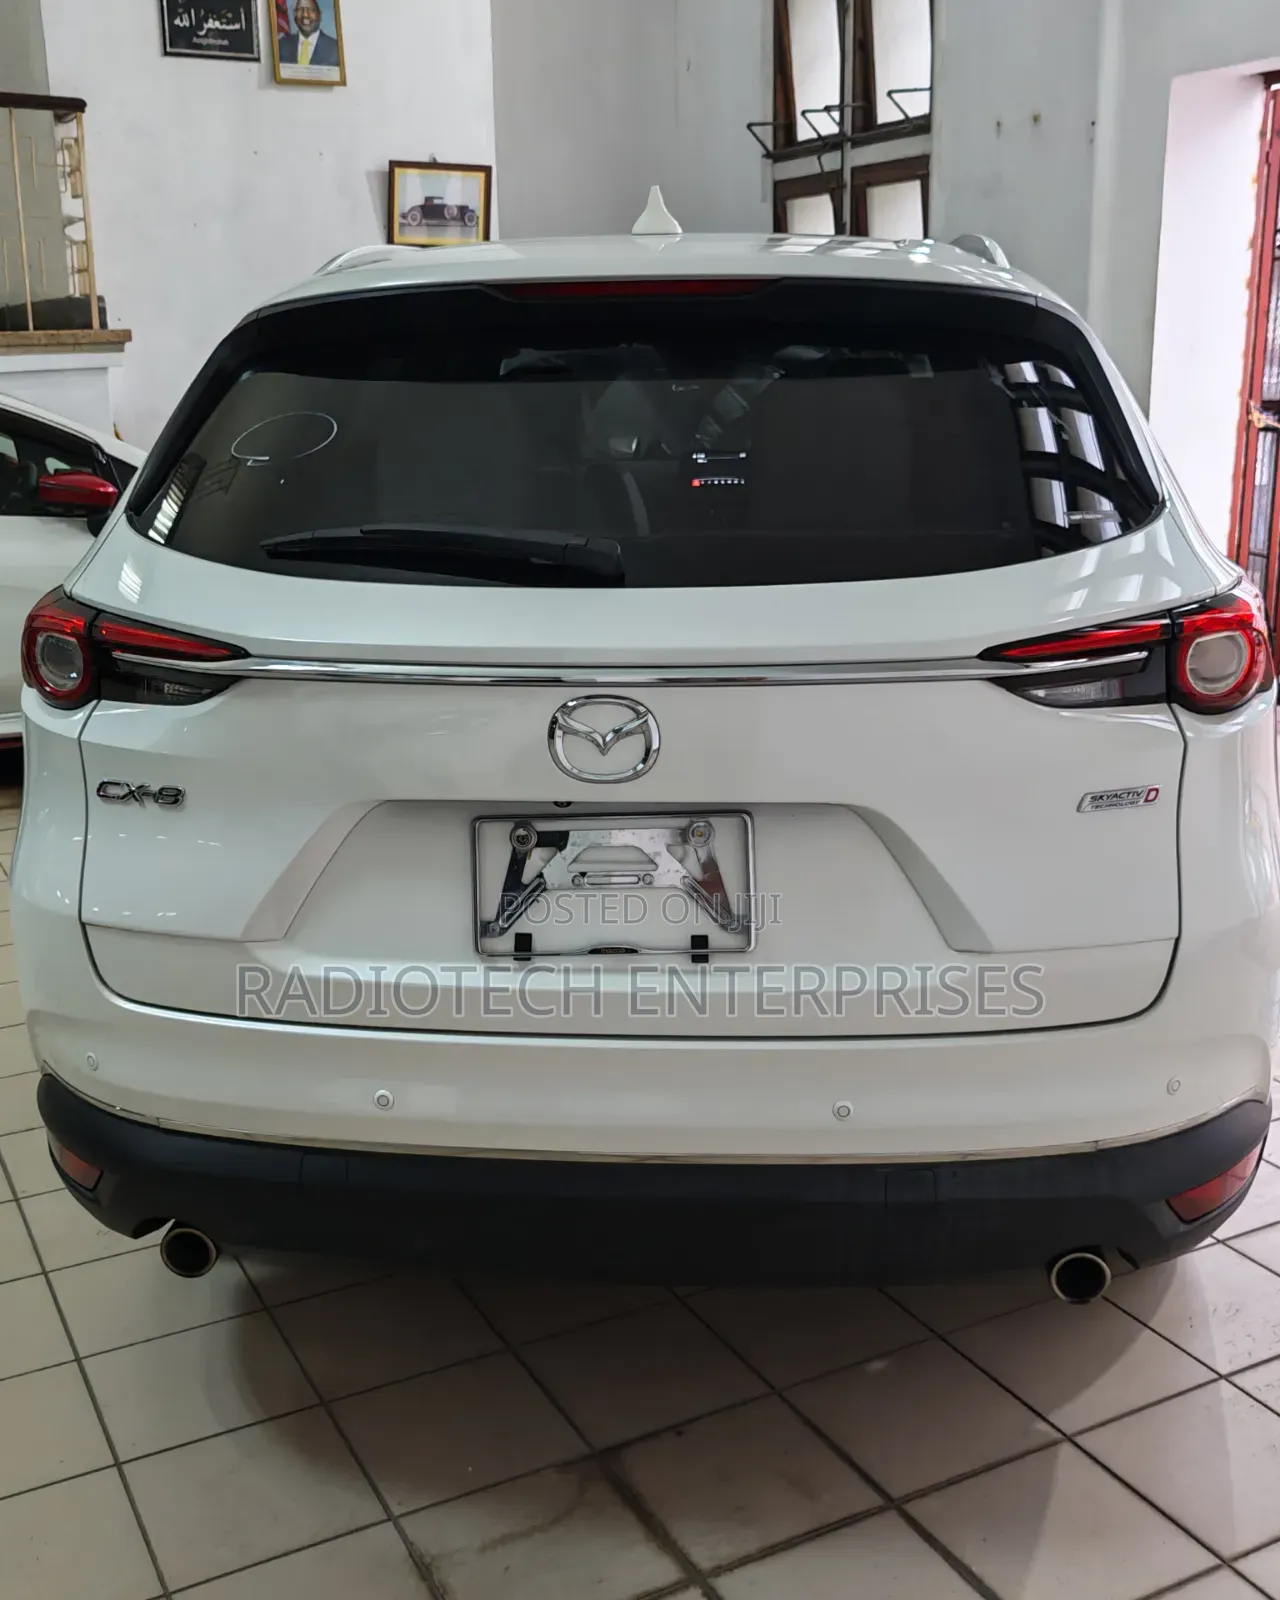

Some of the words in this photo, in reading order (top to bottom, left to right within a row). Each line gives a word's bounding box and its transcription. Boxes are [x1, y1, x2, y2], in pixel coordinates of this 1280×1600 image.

[96, 779, 186, 806] CX-8
[1090, 790, 1143, 802] SKYACTIV
[1090, 800, 1140, 810] TECHNOLOGY
